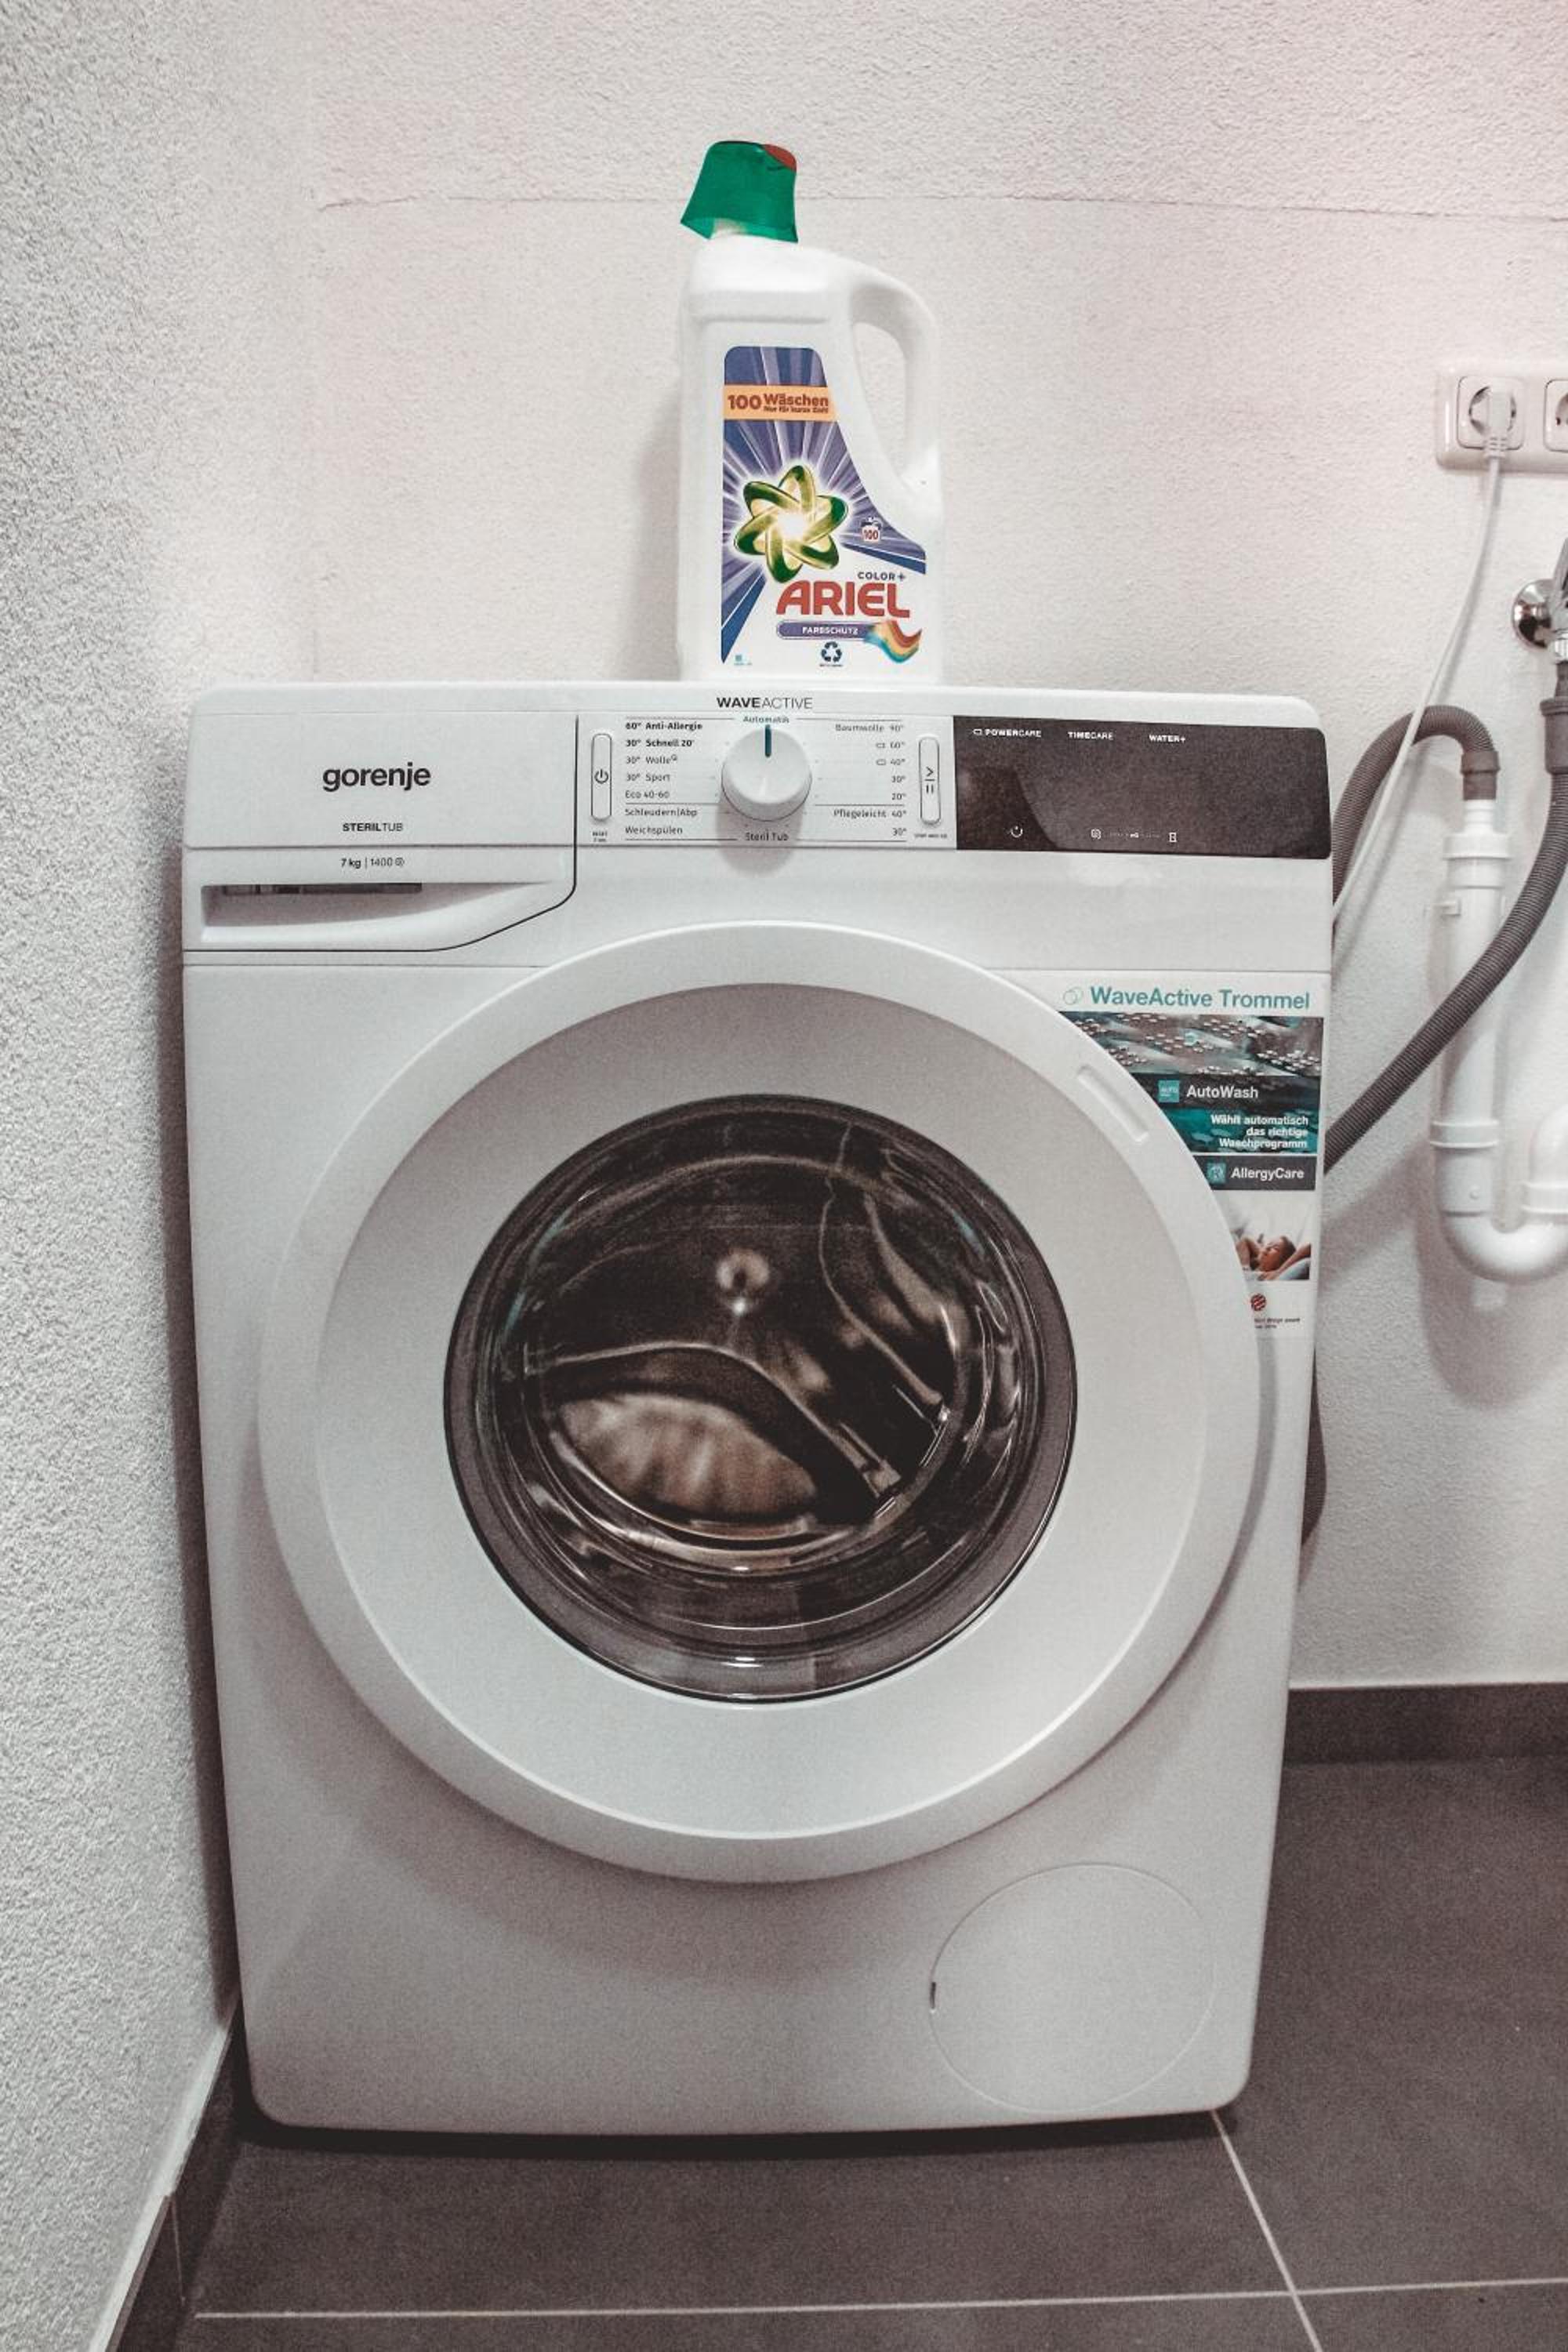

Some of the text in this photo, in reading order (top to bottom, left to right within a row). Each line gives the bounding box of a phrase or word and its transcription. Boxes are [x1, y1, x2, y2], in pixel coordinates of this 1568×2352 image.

[728, 393, 829, 409] 100 Wäschen
[863, 529, 879, 540] 100
[775, 580, 911, 618] ARIEL
[802, 626, 858, 635] FARBSCHUTZ
[717, 697, 813, 709] WAVEACTIVE
[645, 721, 703, 731] Anti-Allergie
[985, 728, 1042, 737] POWERCARE
[1067, 731, 1113, 740] TIMECARE
[1149, 735, 1186, 743] WATER+
[322, 761, 431, 792] gorenje
[645, 773, 670, 782] Sport
[625, 790, 670, 799] Eco 40-60
[833, 808, 887, 818] Pflegeleicht
[343, 822, 404, 832] STERILTUB
[341, 857, 393, 869] 7 kg 1400
[1091, 985, 1310, 1009] WaveActive Trommel
[1186, 1085, 1259, 1098] AutoWash
[1210, 1114, 1308, 1126] Wählt automatisch
[1246, 1127, 1308, 1138] das richtige
[1219, 1138, 1308, 1150] Waschprogramm
[1231, 1167, 1305, 1181] AllergyCare
